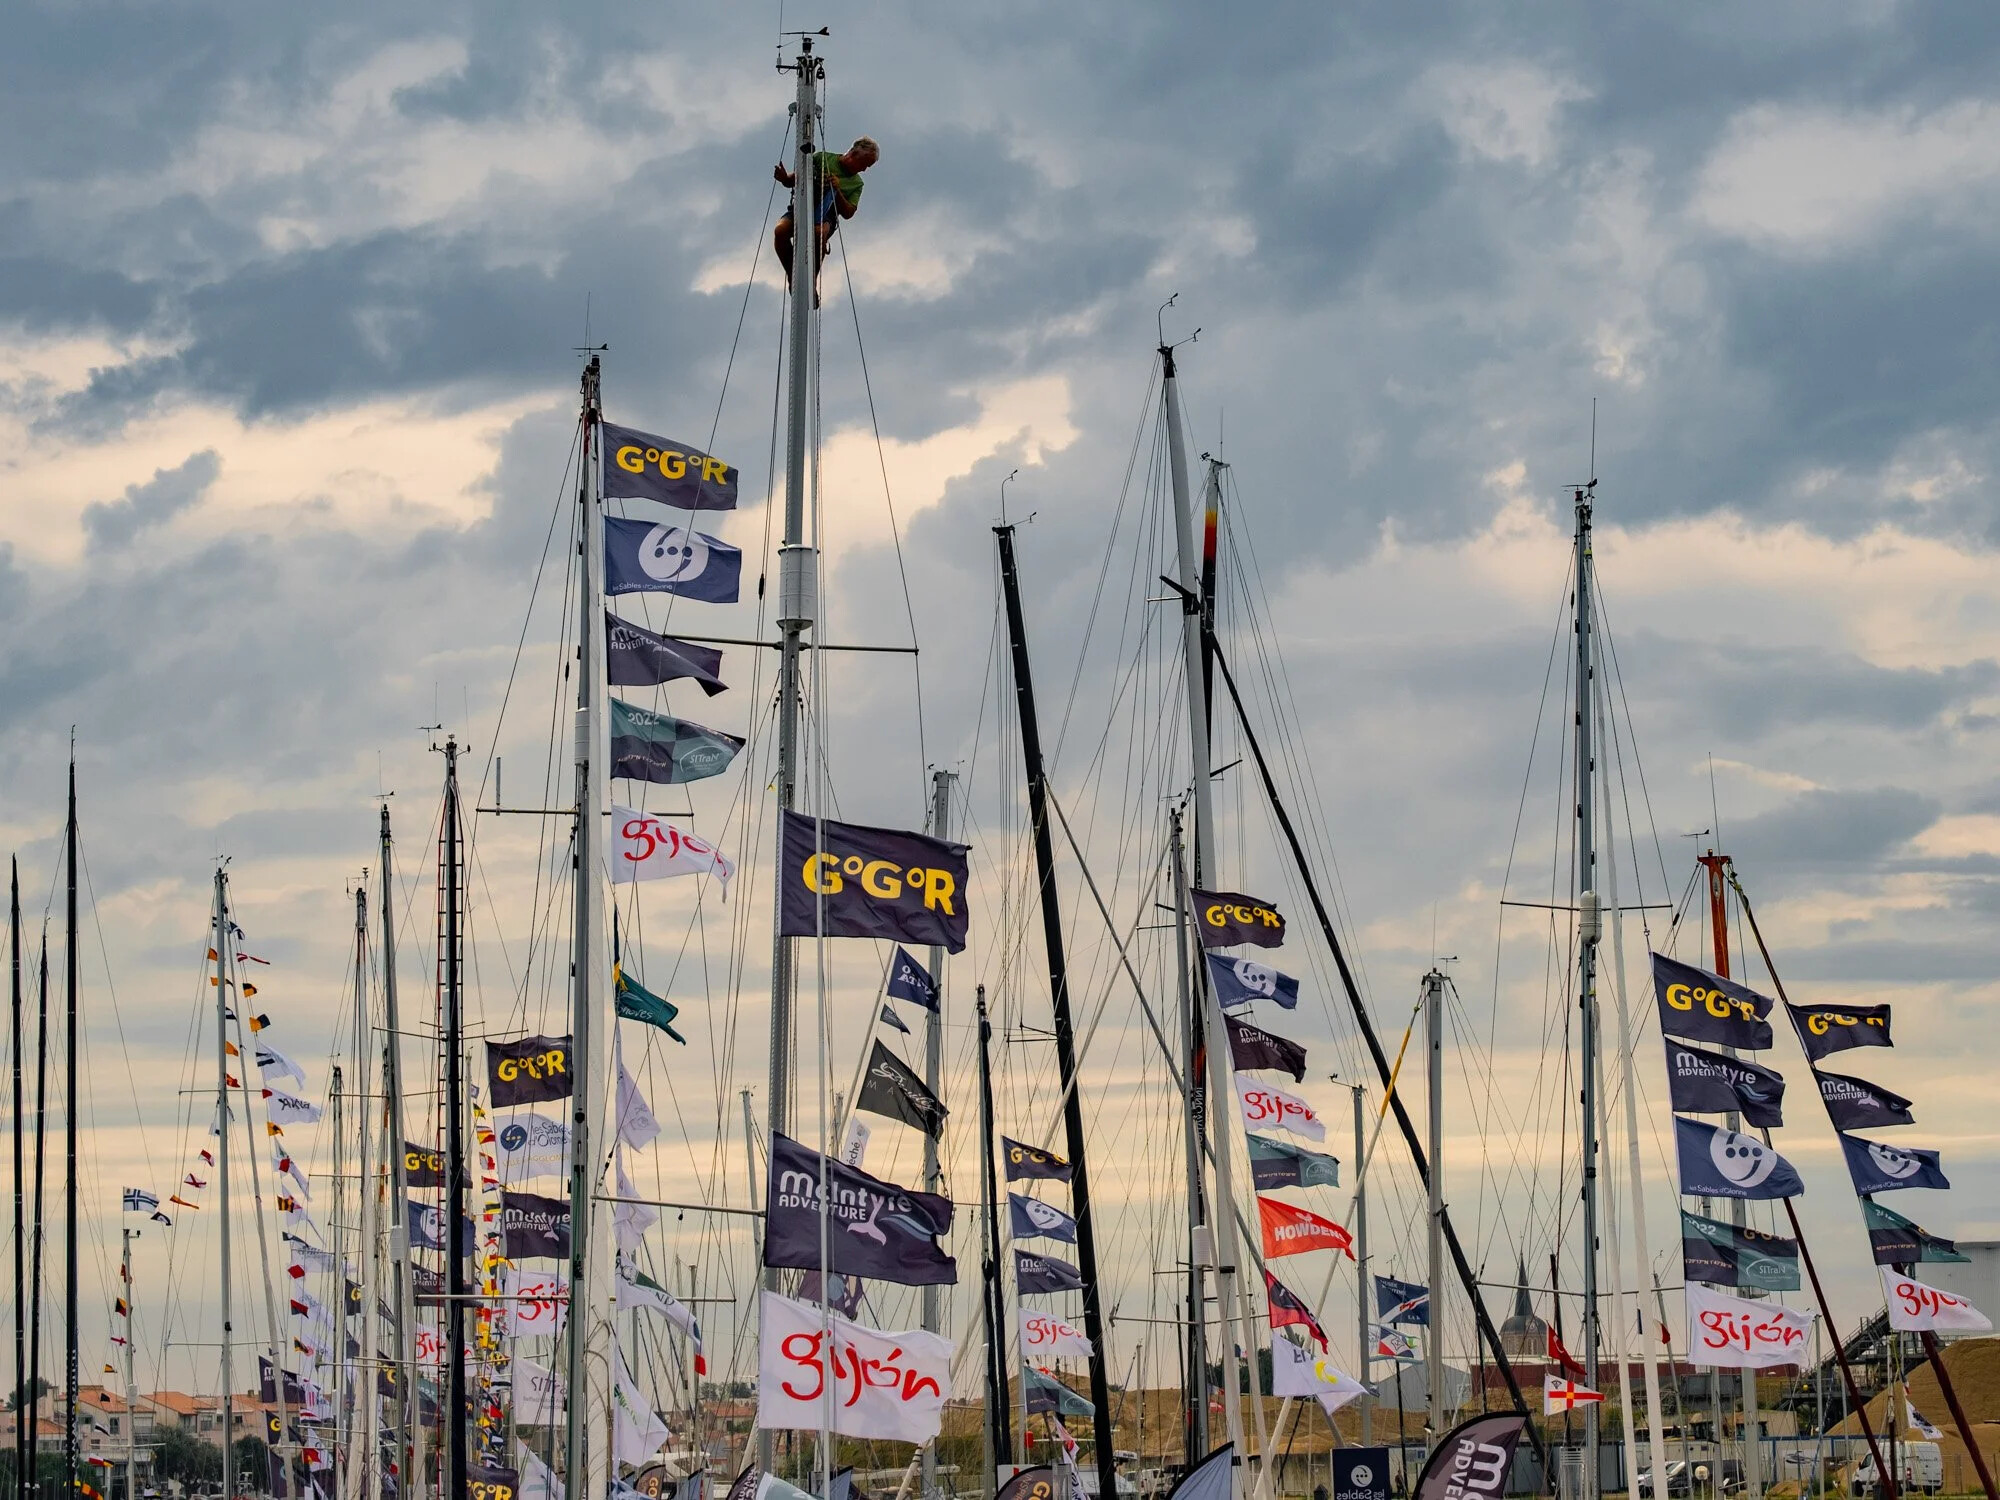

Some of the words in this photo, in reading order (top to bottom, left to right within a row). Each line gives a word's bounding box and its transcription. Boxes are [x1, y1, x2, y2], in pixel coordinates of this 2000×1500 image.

[628, 712, 660, 726] 2022
[1697, 1184, 1719, 1194] Sables
[1896, 1283, 1968, 1317] gij
[1700, 1311, 1803, 1350] gijón
[781, 1329, 940, 1407] gijón
[1444, 1439, 1476, 1500] ADVE
